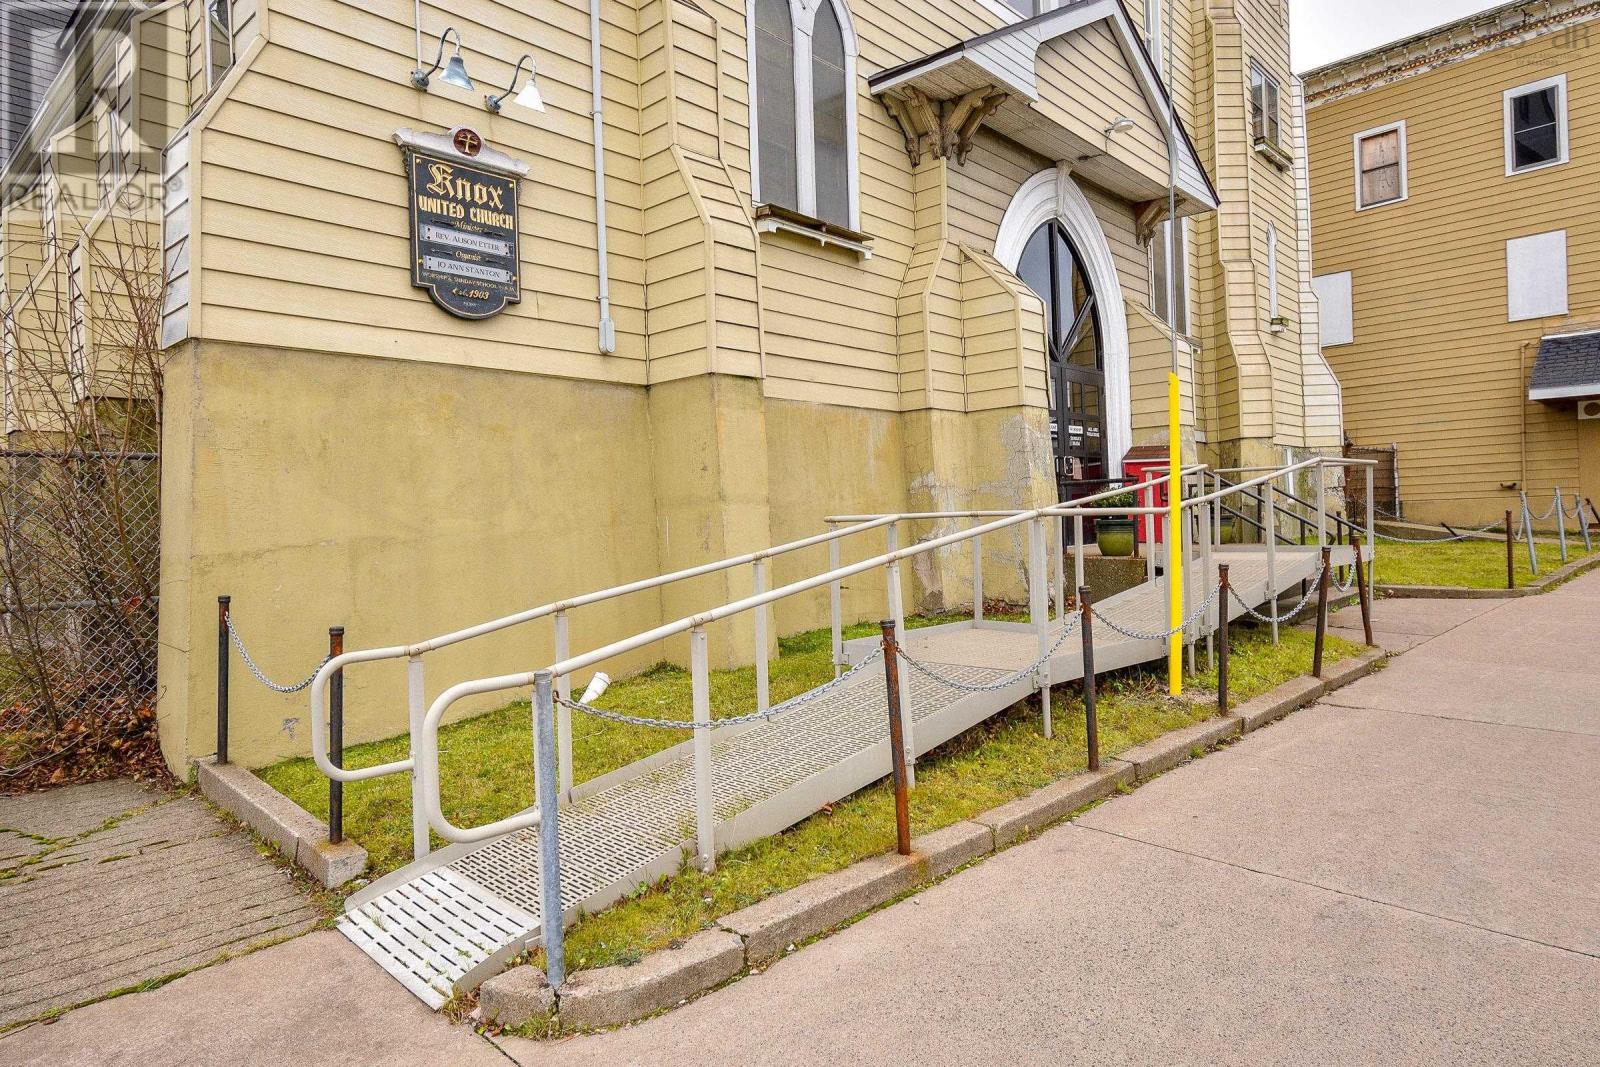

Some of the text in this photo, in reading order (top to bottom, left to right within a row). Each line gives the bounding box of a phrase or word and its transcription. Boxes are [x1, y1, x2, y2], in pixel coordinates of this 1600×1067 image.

[427, 163, 504, 210] Knox
[418, 195, 514, 230] UNITED CHURCH
[454, 236, 478, 247] ALISON
[449, 262, 465, 271] ANN
[466, 266, 500, 278] STANTON
[468, 289, 490, 300] 1903
